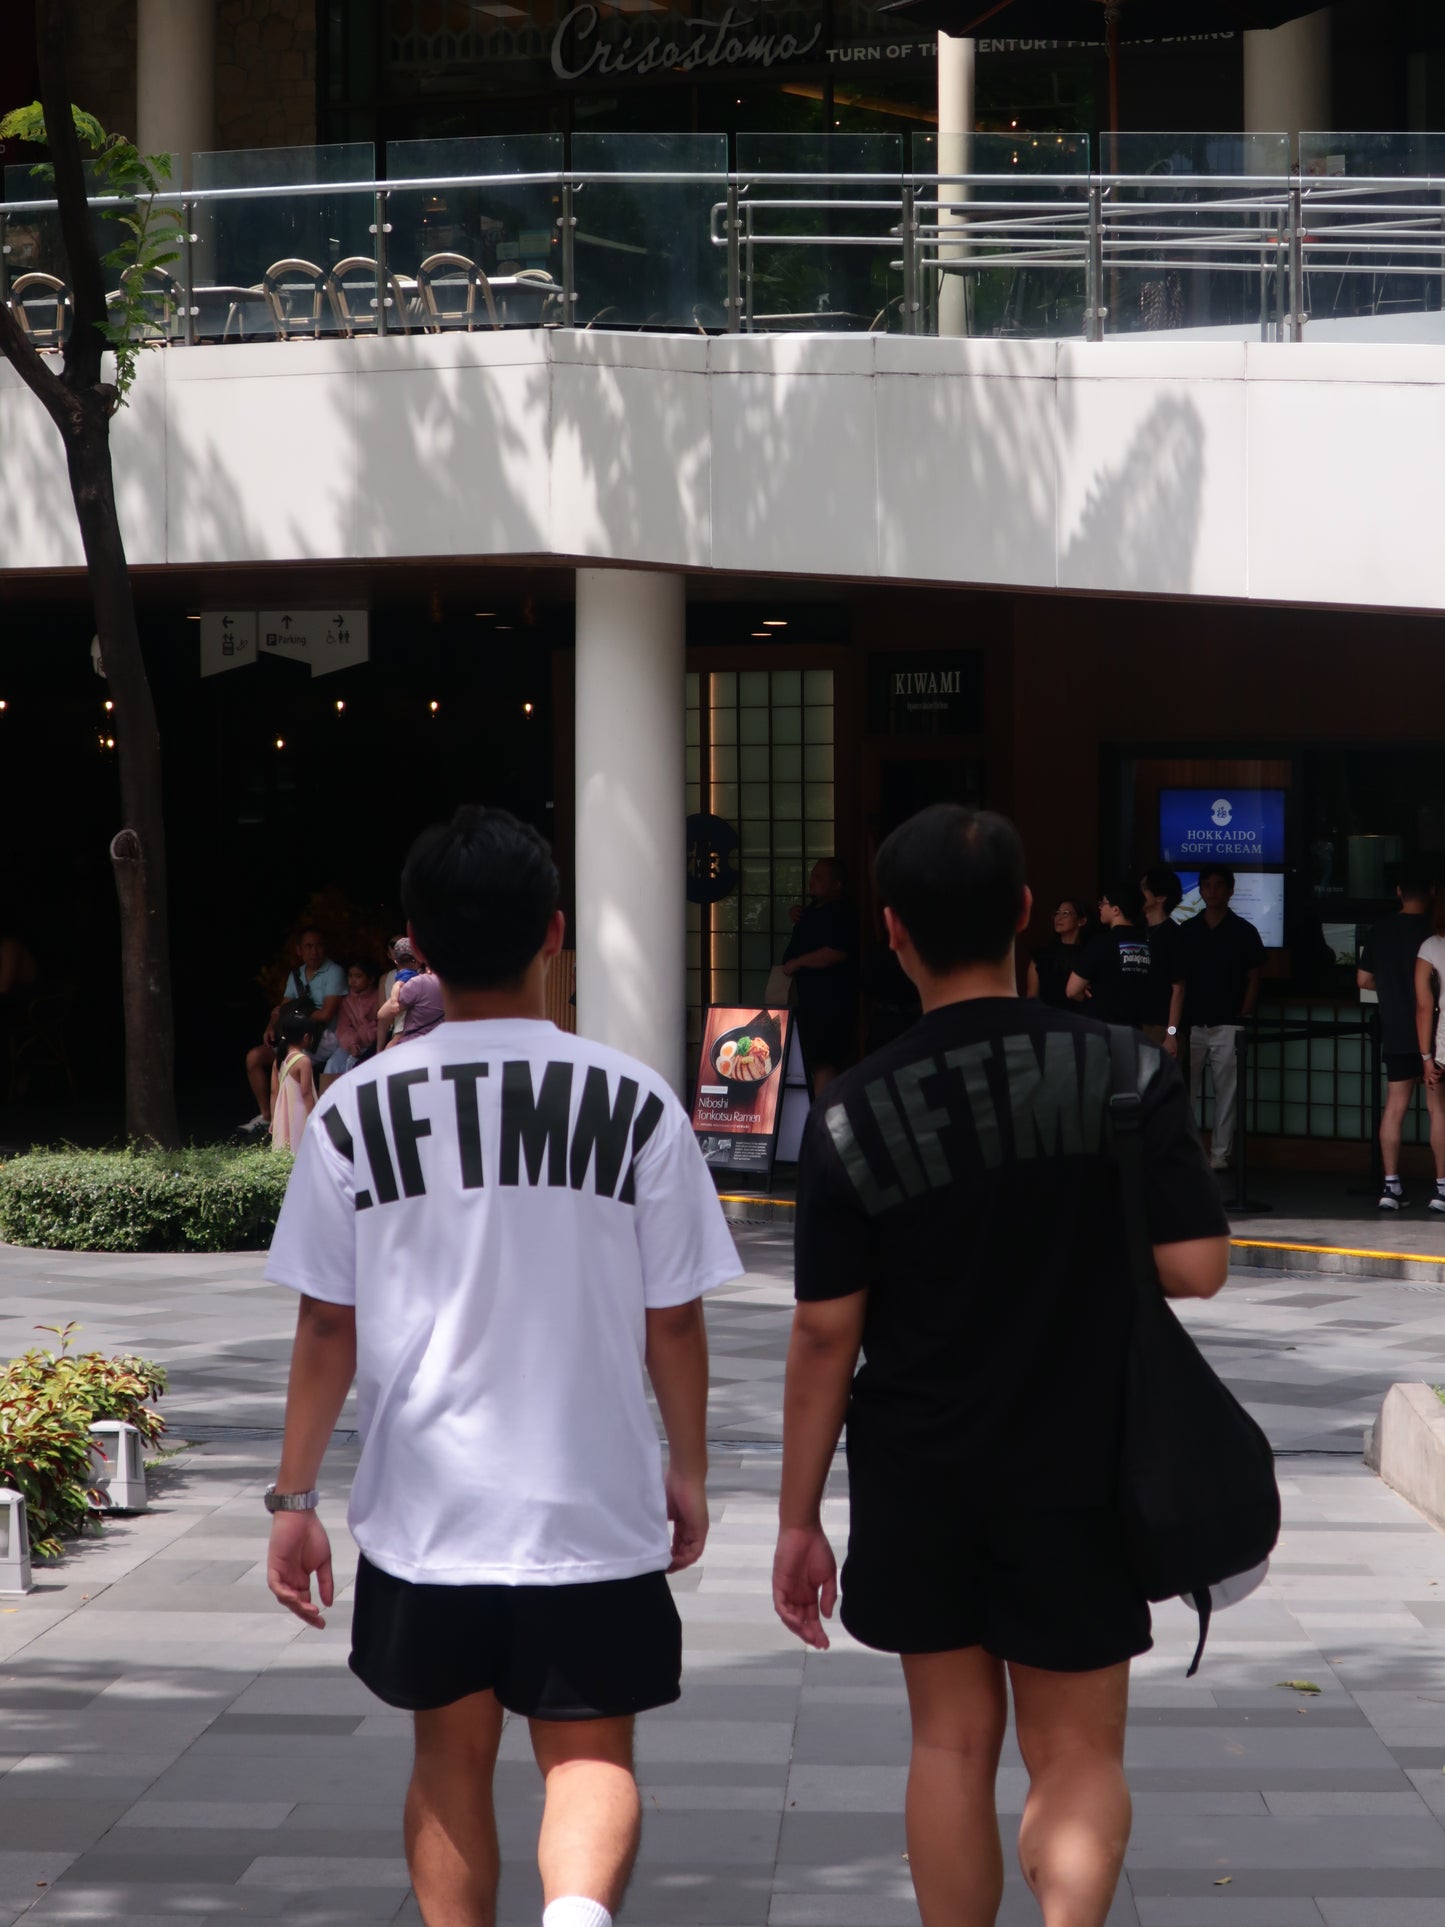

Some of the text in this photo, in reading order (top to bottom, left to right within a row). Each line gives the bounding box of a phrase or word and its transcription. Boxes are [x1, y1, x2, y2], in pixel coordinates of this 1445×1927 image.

[551, 3, 822, 79] Crisostomo
[826, 46, 881, 63] TURN
[886, 44, 913, 59] OF
[278, 636, 306, 646] Parking
[895, 671, 961, 695] KIWAMI
[1187, 830, 1256, 841] HOKKAIDO
[1181, 843, 1262, 854] SOFT CREAM
[698, 1097, 728, 1109] Niboshi
[697, 1110, 761, 1122] Tonkotsu Ramen
